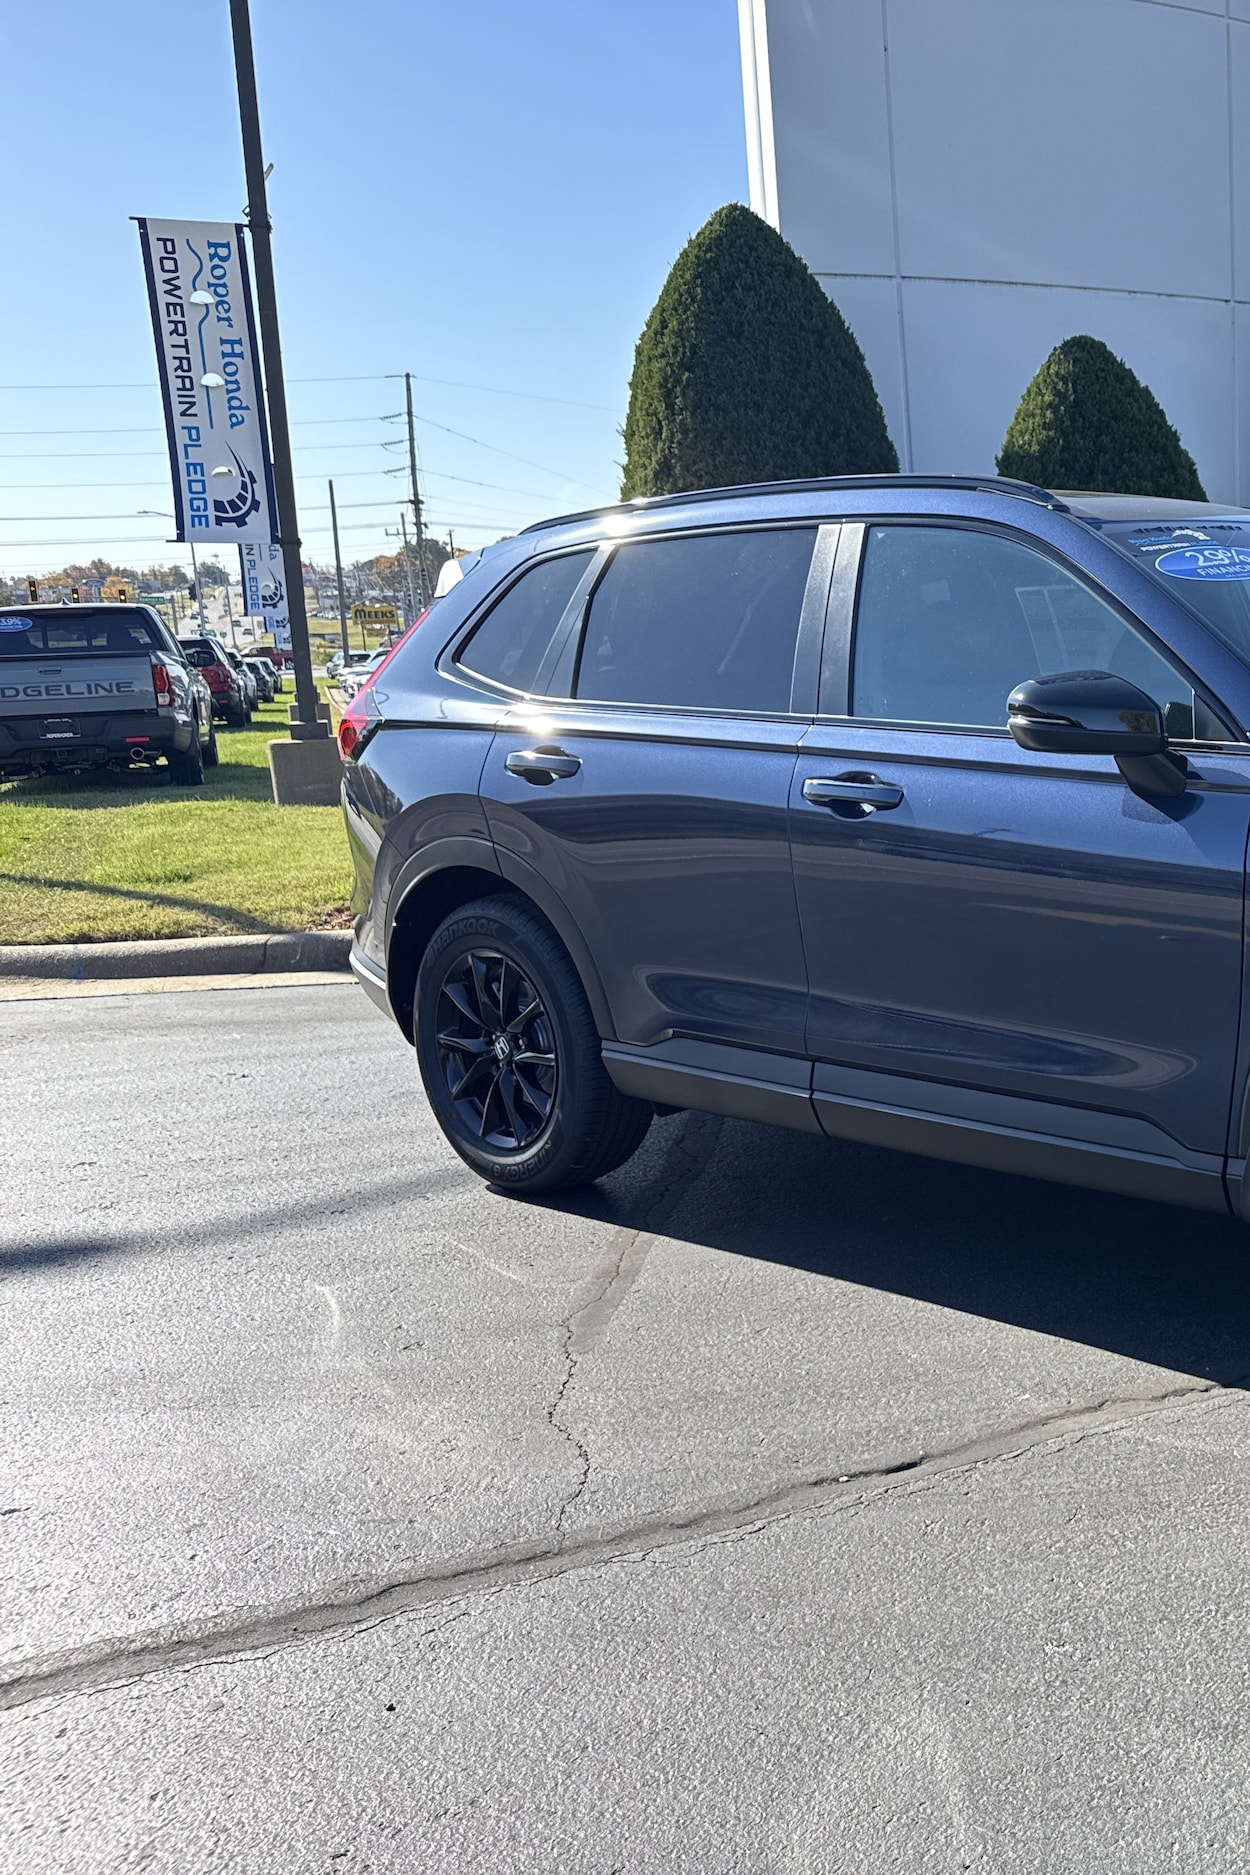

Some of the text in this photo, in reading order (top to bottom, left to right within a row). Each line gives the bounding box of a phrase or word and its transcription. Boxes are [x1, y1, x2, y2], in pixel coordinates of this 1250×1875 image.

[156, 237, 209, 528] POWERTRAIN PLEDGE
[207, 240, 250, 429] Roper Honda
[246, 560, 260, 610] PLEDGE
